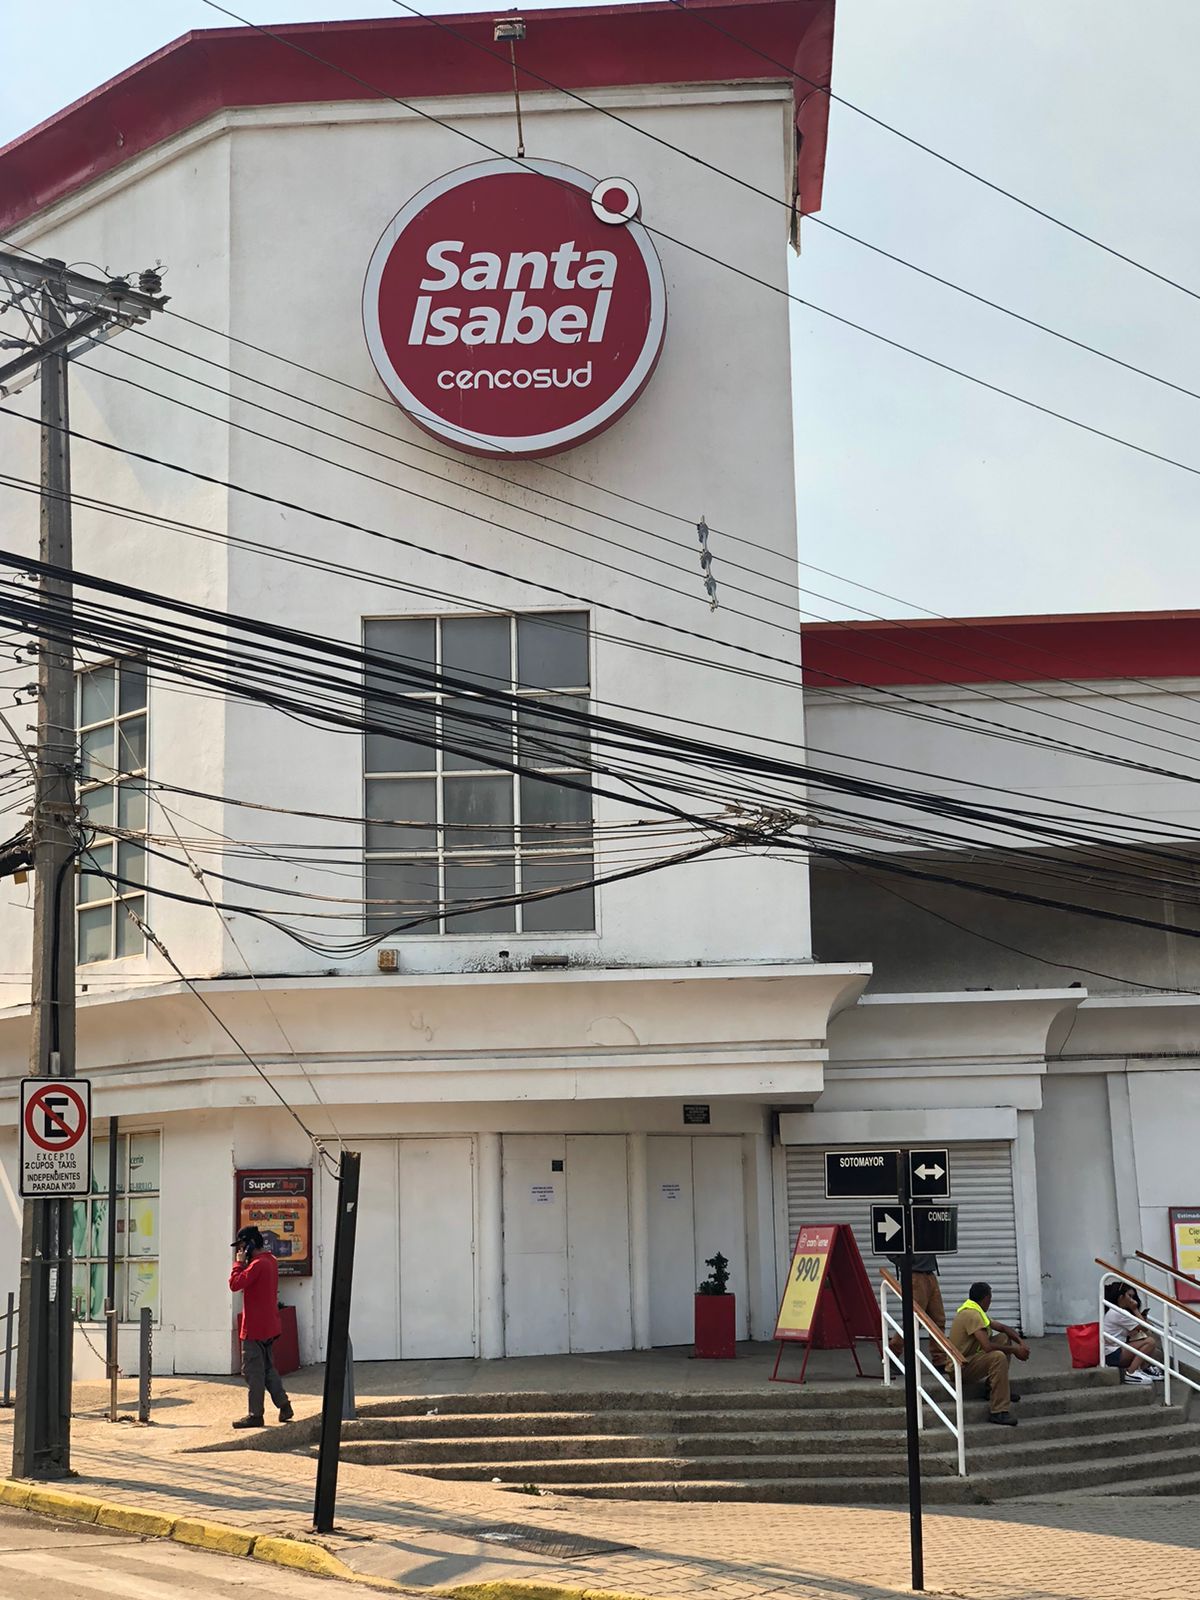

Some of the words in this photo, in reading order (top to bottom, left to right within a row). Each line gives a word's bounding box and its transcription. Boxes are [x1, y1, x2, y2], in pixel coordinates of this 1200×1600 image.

[419, 240, 618, 292] Santa
[408, 290, 613, 346] Isabel
[437, 360, 592, 390] cencosud
[36, 1153, 75, 1161] EXCEPTO
[839, 1156, 885, 1168] SOTOMAYOR
[58, 1161, 77, 1169] TAXIS
[27, 1172, 81, 1181] INDEPENDIENTES
[32, 1183, 60, 1191] PARADA
[248, 1181, 275, 1191] Super
